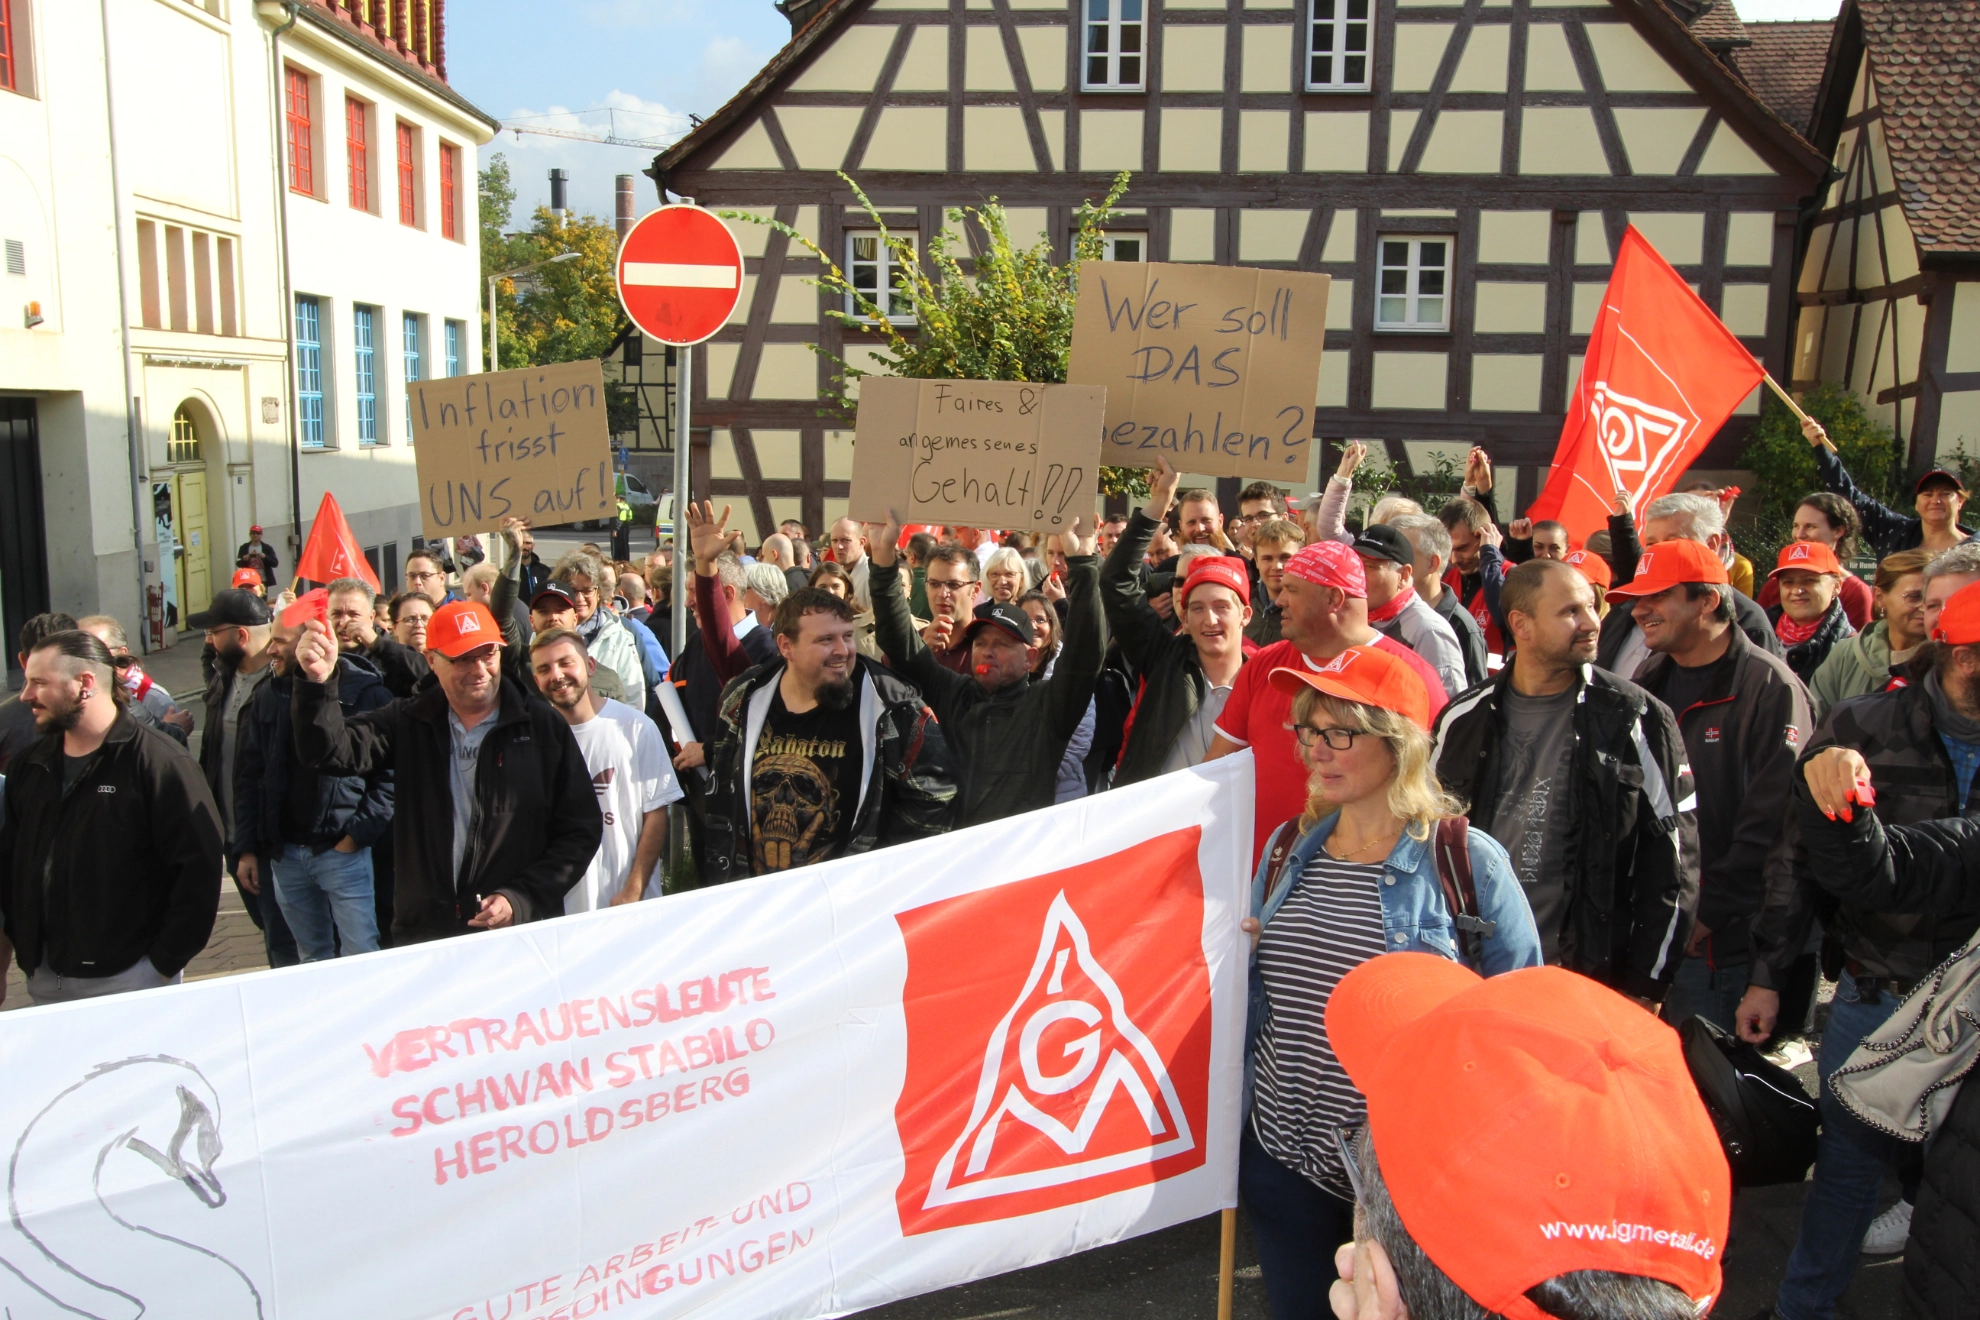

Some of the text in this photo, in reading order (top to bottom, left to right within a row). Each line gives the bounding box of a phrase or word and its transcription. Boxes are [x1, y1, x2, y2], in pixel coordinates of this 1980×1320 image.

[1100, 276, 1293, 342] Wer soll
[1126, 344, 1240, 388] DAS
[418, 375, 596, 430] Inflation
[934, 384, 1039, 415] Faires &
[475, 421, 566, 465] frisst
[1102, 405, 1306, 464] ezahlen?
[430, 461, 607, 528] UNS auf!
[754, 720, 846, 761] Sabaton
[362, 966, 777, 1079] VERTRAUENSLEUTE
[391, 1017, 776, 1137] SCHWAN STABILO
[434, 1066, 751, 1186] HEROLDSBERG
[731, 1181, 812, 1225] UND
[1539, 1219, 1716, 1260] www.igmetall.de
